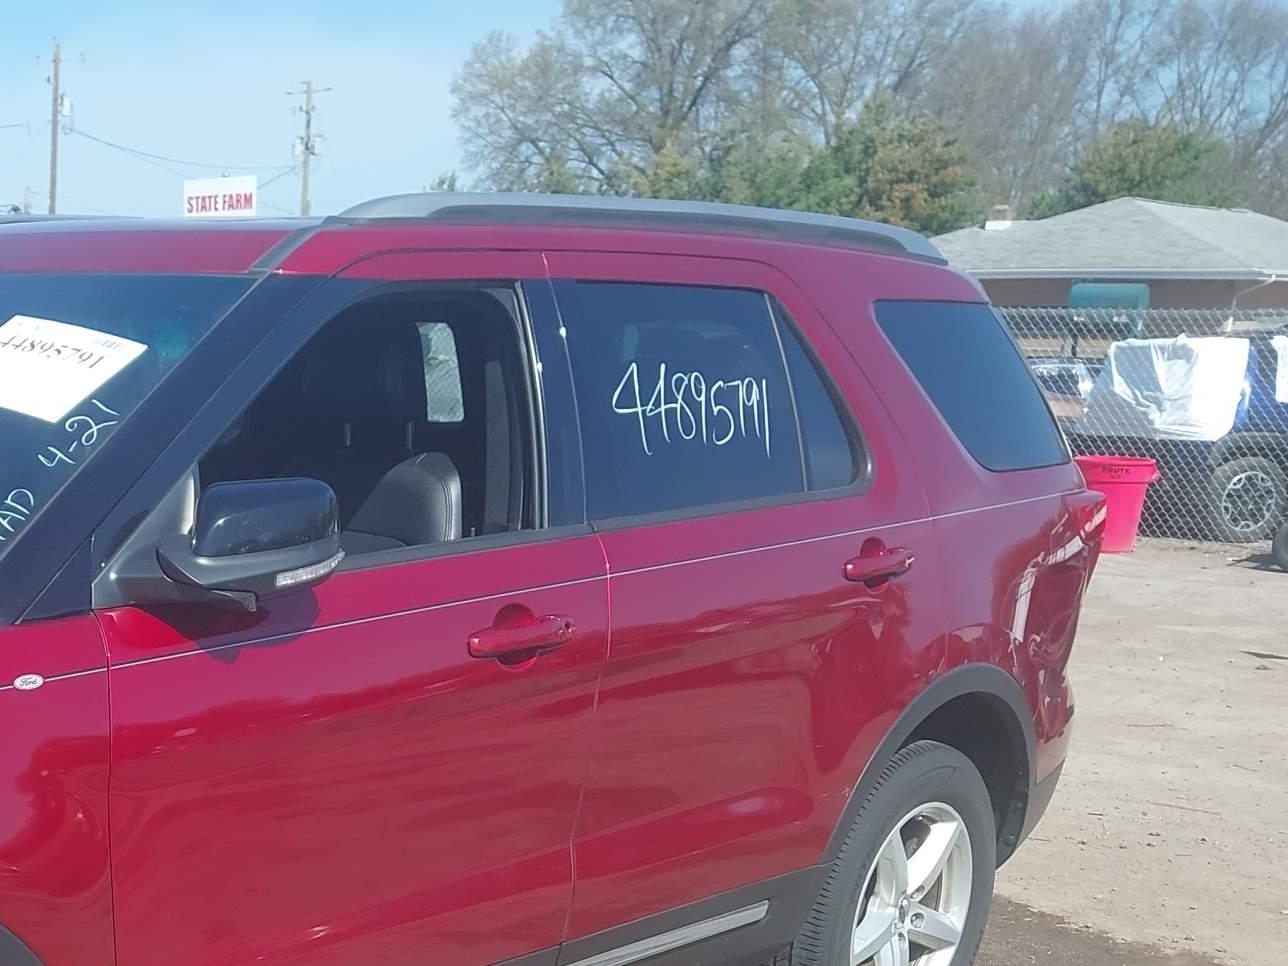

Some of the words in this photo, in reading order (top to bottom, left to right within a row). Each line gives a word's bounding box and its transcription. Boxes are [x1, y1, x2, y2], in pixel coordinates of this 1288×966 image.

[186, 194, 219, 214] STATE
[222, 191, 253, 211] FARM
[38, 398, 120, 467] 4-21
[612, 362, 771, 459] 44895791
